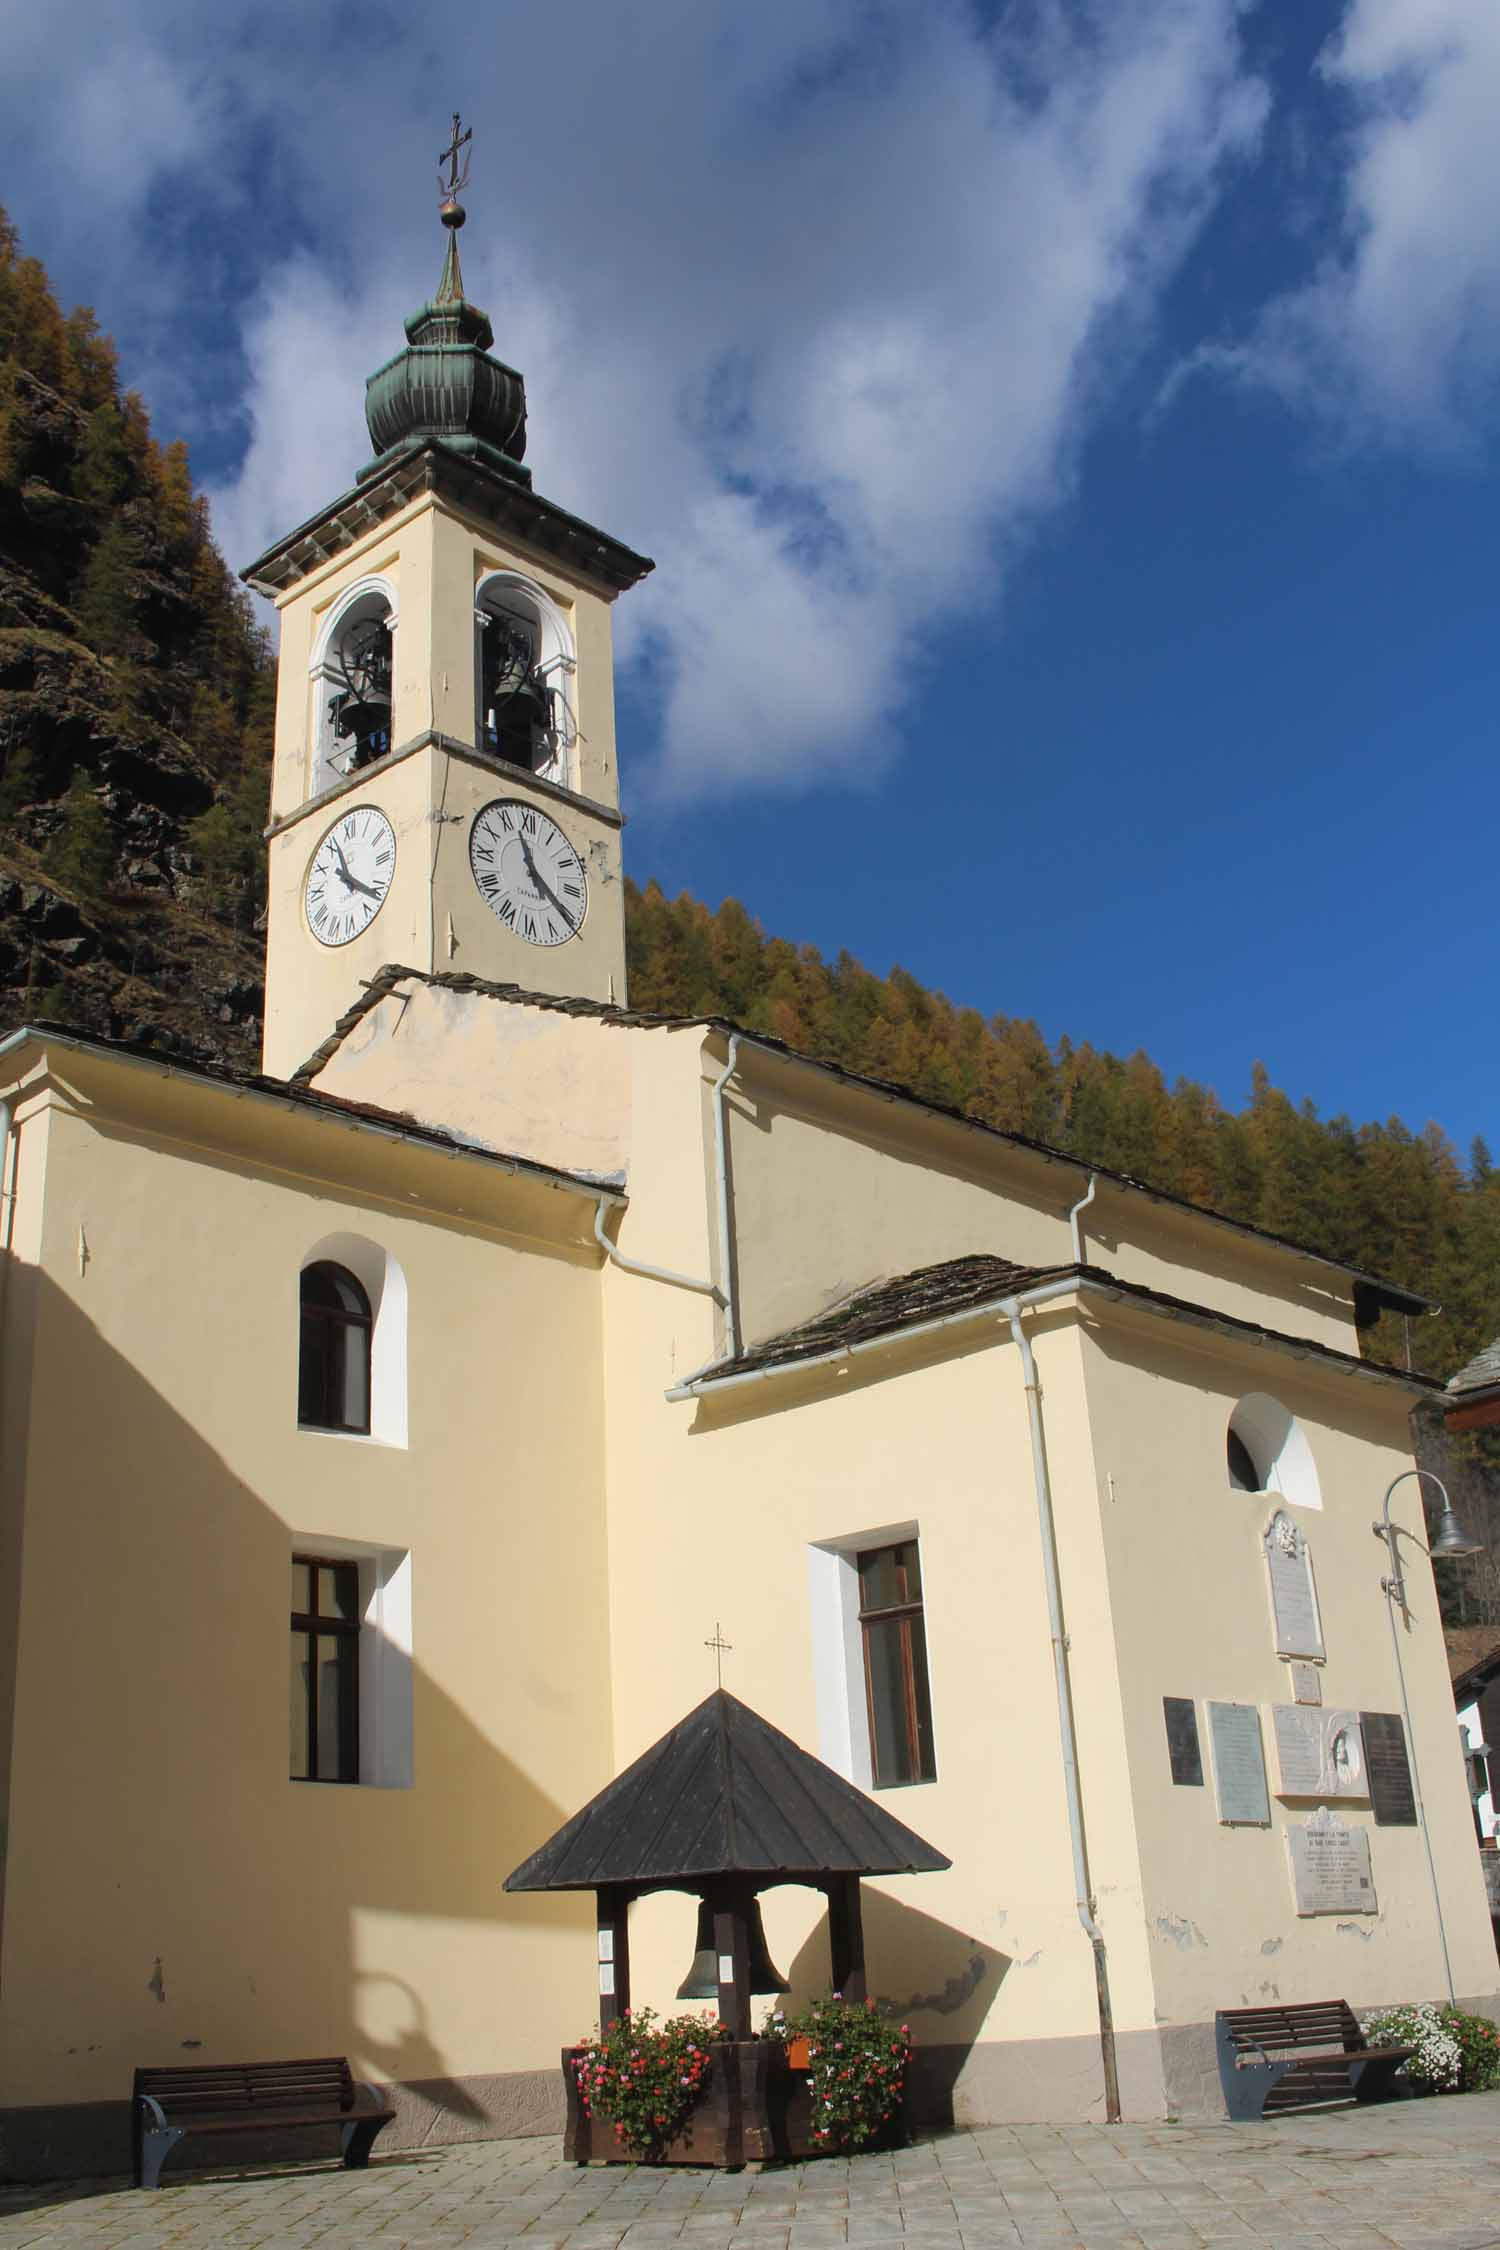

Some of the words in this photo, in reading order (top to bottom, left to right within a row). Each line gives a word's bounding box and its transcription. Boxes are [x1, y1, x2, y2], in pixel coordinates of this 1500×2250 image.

[344, 818, 356, 842] XII
[362, 816, 371, 838] I
[498, 810, 514, 832] XI
[522, 811, 536, 834] XII
[372, 828, 386, 847] II
[482, 822, 500, 842] X
[546, 832, 554, 846] I
[326, 836, 339, 858] X
[476, 844, 494, 863] IX
[376, 850, 390, 866] III
[558, 859, 574, 868] II
[315, 864, 328, 875] X
[480, 874, 500, 898] VIII
[563, 884, 580, 898] III
[363, 903, 372, 918] V
[500, 900, 516, 925] VII
[346, 914, 355, 936] VI
[525, 914, 536, 937] VI
[548, 919, 558, 938] V
